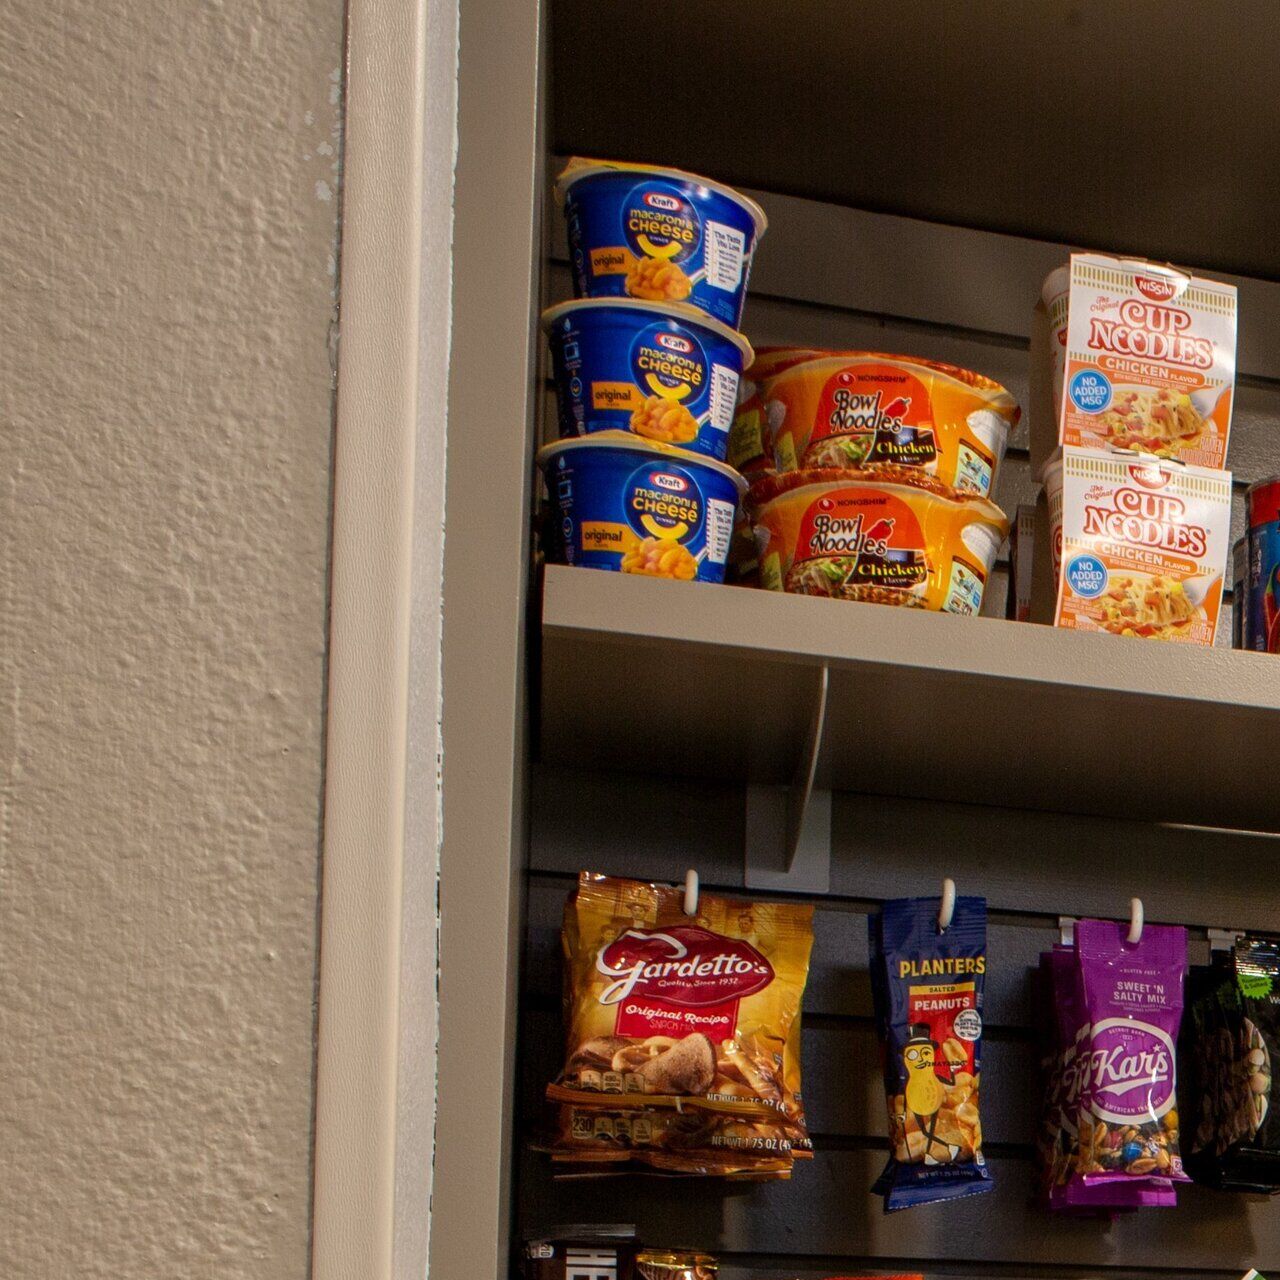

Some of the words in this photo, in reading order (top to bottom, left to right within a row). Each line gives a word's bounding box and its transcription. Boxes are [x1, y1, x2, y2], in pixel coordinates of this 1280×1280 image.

[651, 196, 674, 208] Kraft
[630, 209, 685, 227] macaroni
[594, 254, 625, 267] original
[1139, 281, 1172, 295] NISSIN
[1120, 299, 1192, 333] CUP
[663, 337, 687, 350] Kraft
[1088, 319, 1214, 370] NOODLES
[640, 346, 695, 369] macaroni
[1105, 357, 1169, 378] CHICKEN
[1170, 373, 1198, 385] FLAVOR
[857, 375, 907, 383] NONGSHIM
[1082, 377, 1097, 386] NO
[595, 390, 631, 402] original
[1074, 386, 1107, 396] ADDED
[834, 390, 883, 410] Bowl
[1081, 396, 1102, 405] MSG
[831, 410, 903, 432] Noodles
[877, 442, 934, 454] Chicken
[658, 476, 681, 489] Kraft
[634, 487, 690, 505] macaroni
[1114, 487, 1185, 522] CUP
[815, 515, 864, 535] Bowl
[1084, 506, 1206, 557] NOODLES
[585, 530, 622, 543] original
[810, 534, 887, 555] Noodles
[1102, 543, 1163, 566] CHICKEN
[1164, 562, 1191, 571] FLAVOR
[858, 564, 925, 576] Chicken
[1079, 562, 1092, 570] NO
[1072, 571, 1103, 580] ADDED
[596, 930, 768, 1005] Gardetto's
[900, 956, 986, 978] PLANTERS
[1117, 981, 1150, 993] SWEET
[914, 997, 970, 1011] PEANUTS
[1114, 991, 1142, 1001] SALTY
[1147, 994, 1166, 1004] MIX
[626, 1005, 682, 1020] Original
[685, 1013, 729, 1024] Recipe
